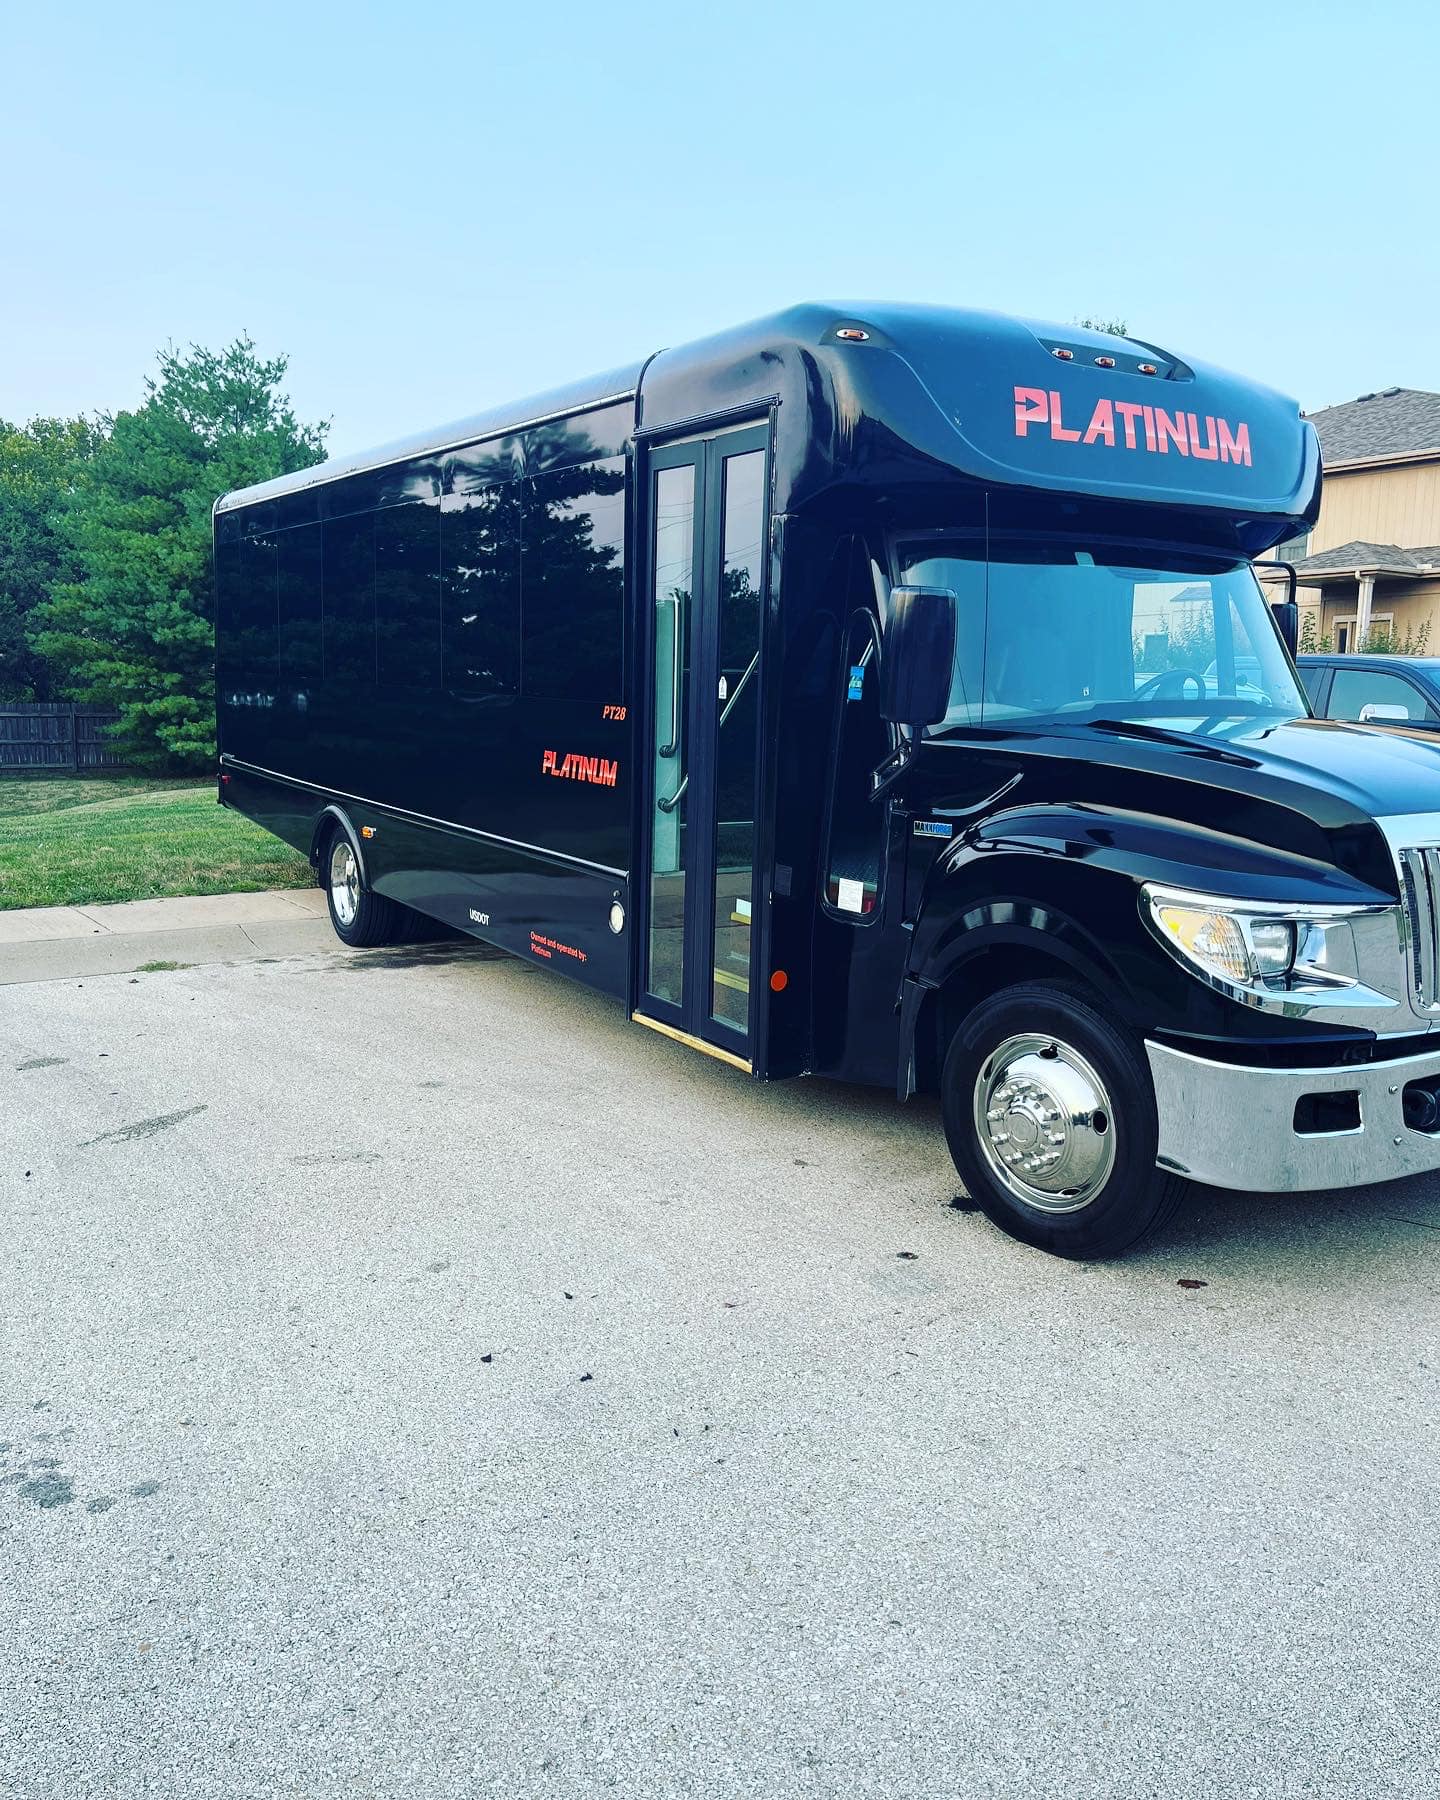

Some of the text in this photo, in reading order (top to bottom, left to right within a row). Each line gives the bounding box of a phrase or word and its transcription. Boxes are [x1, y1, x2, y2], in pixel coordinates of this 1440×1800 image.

[1014, 386, 1252, 467] PLATINUM
[602, 705, 627, 721] PT28
[542, 750, 618, 787] PLATINUM
[469, 907, 490, 926] USDOT
[530, 931, 547, 945] Owned
[547, 939, 556, 949] and
[556, 943, 578, 958] operated
[530, 943, 552, 959] Platinum
